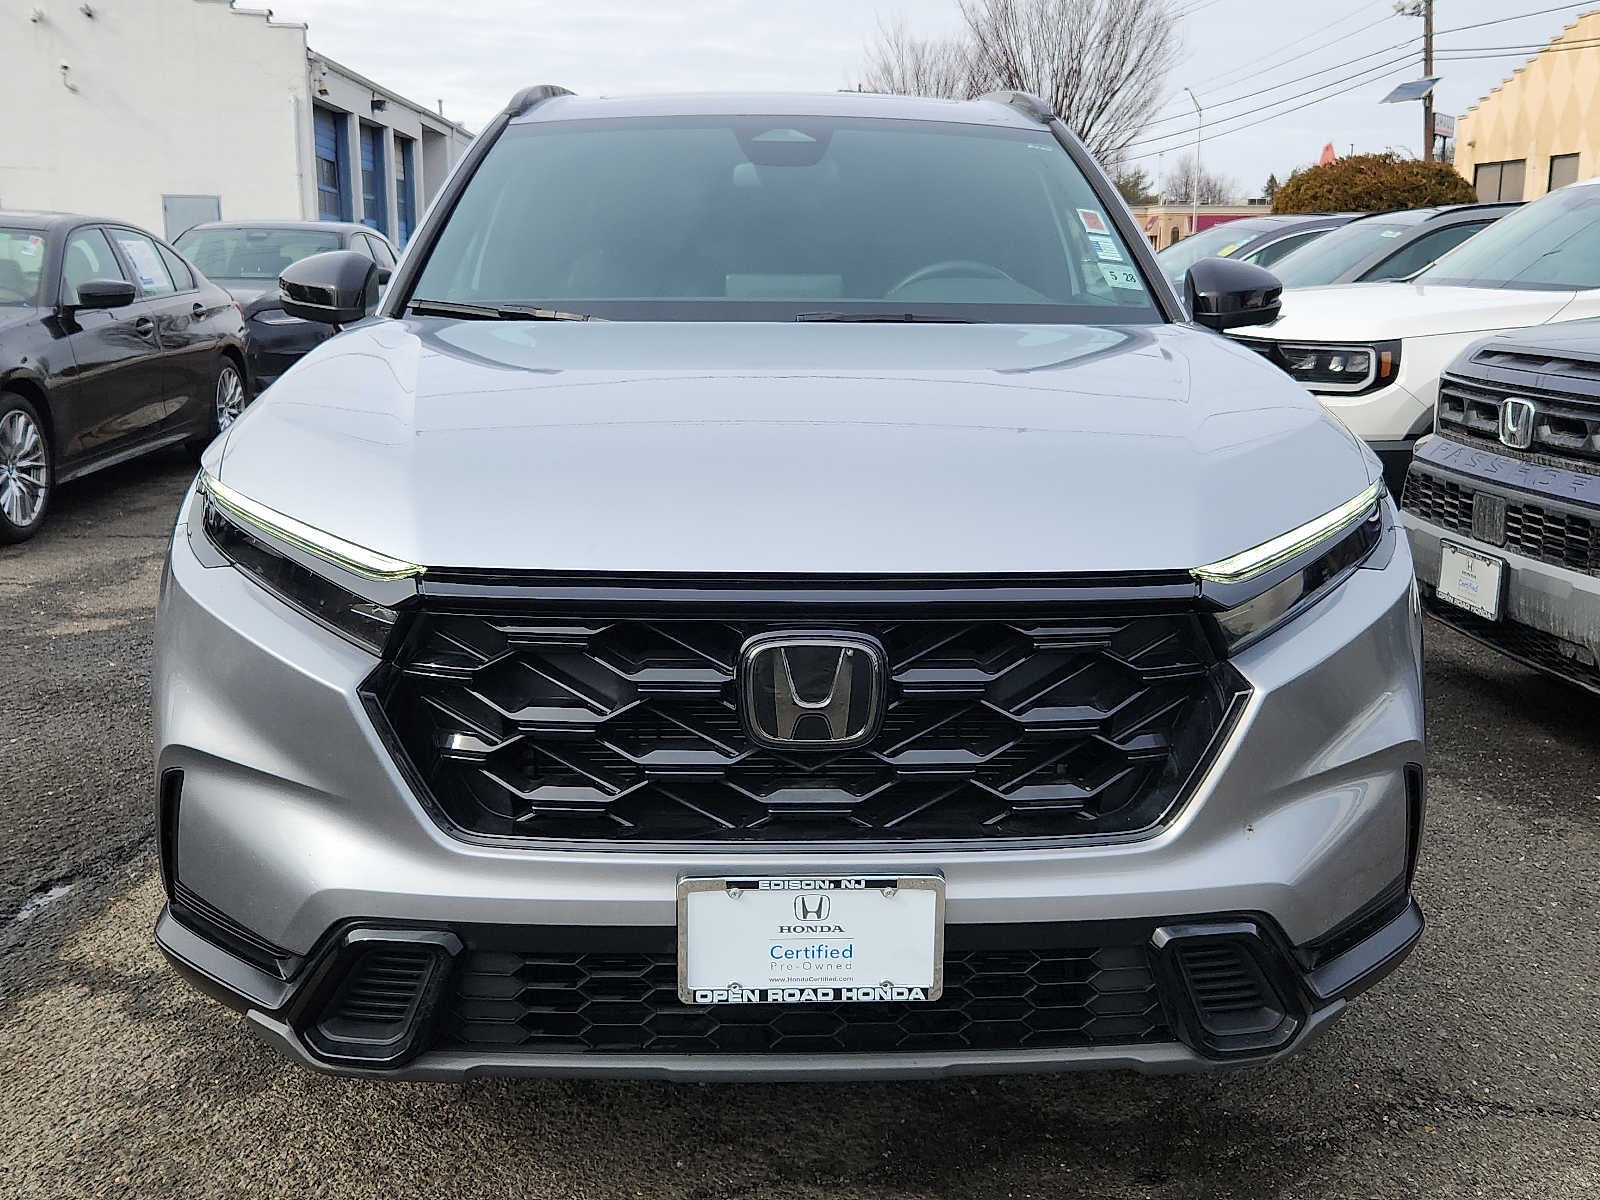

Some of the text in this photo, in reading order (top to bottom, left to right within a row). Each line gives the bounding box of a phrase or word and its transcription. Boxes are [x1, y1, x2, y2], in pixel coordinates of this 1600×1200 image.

[758, 879, 866, 890] EDISON, NJ
[778, 925, 846, 933] HONDA
[770, 944, 853, 959] Certified
[770, 961, 852, 971] Pre-Owned
[695, 986, 926, 1003] OPEN ROAD HONDA
